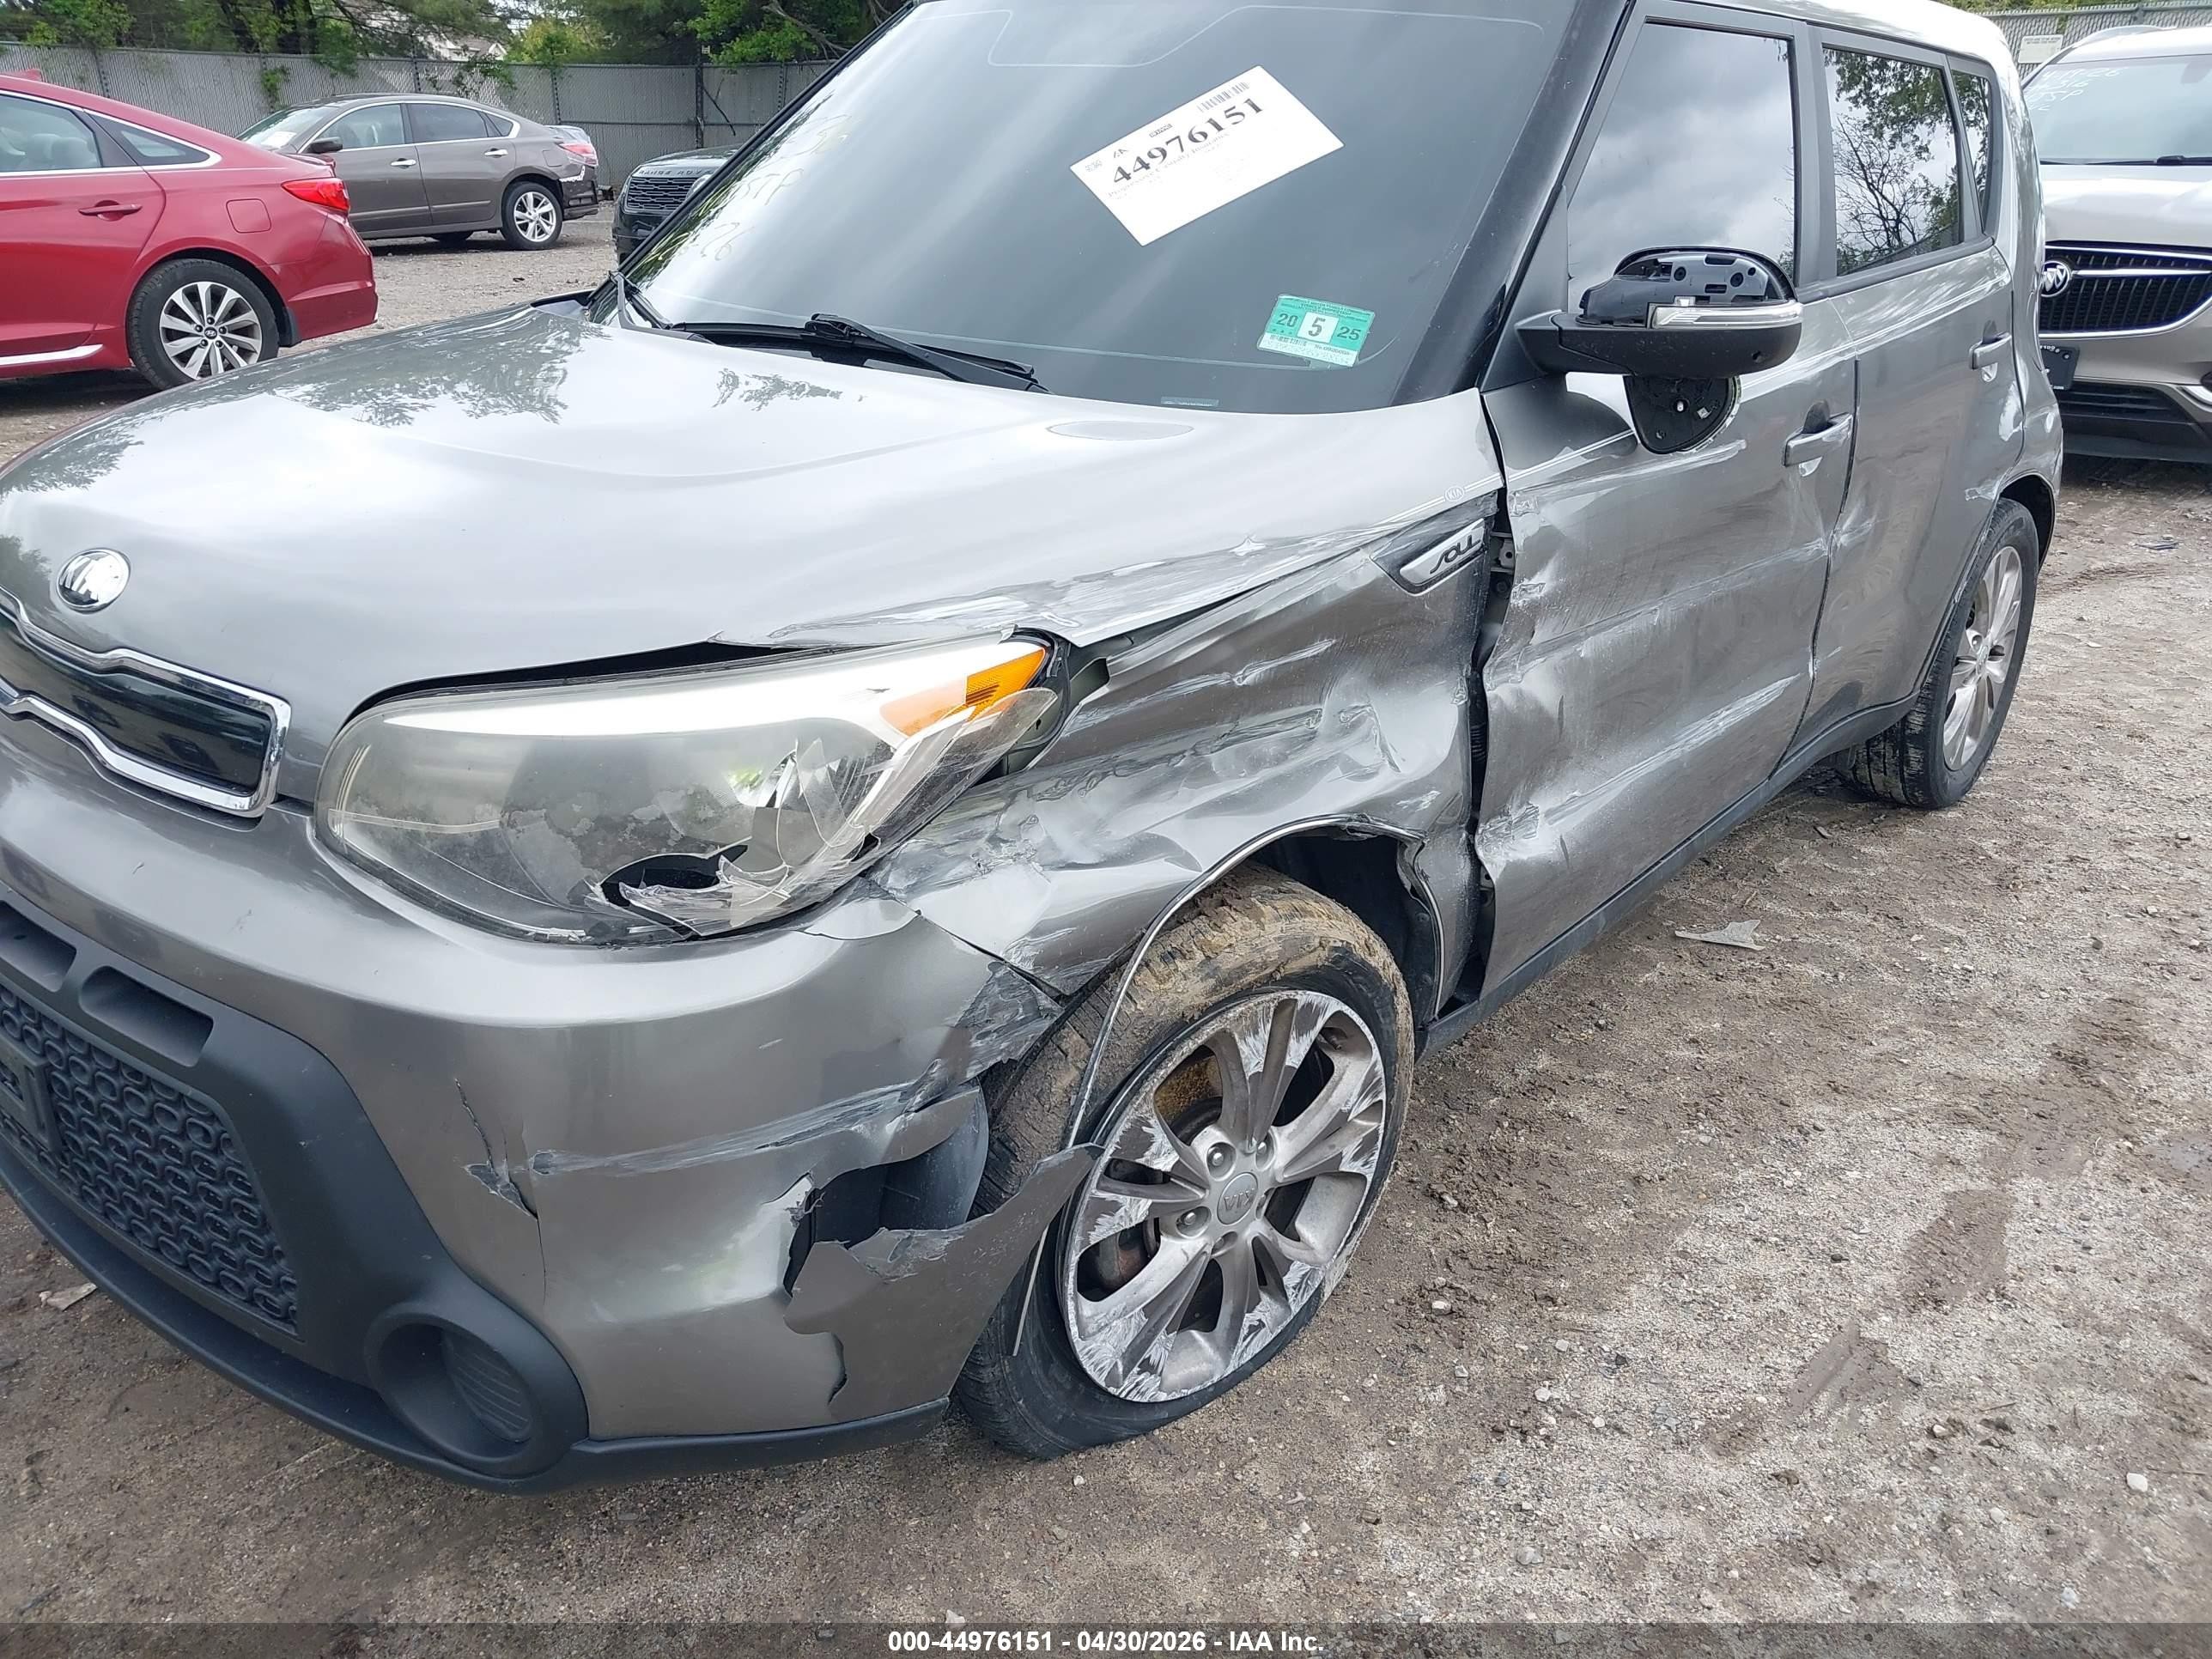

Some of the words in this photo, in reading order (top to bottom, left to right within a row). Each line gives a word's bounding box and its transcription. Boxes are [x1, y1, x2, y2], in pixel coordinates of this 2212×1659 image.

[1113, 97, 1264, 184] 44976151
[1276, 313, 1298, 328] 20
[1308, 316, 1326, 337] 5
[1337, 326, 1362, 341] 25
[1224, 1188, 1255, 1212] KIA
